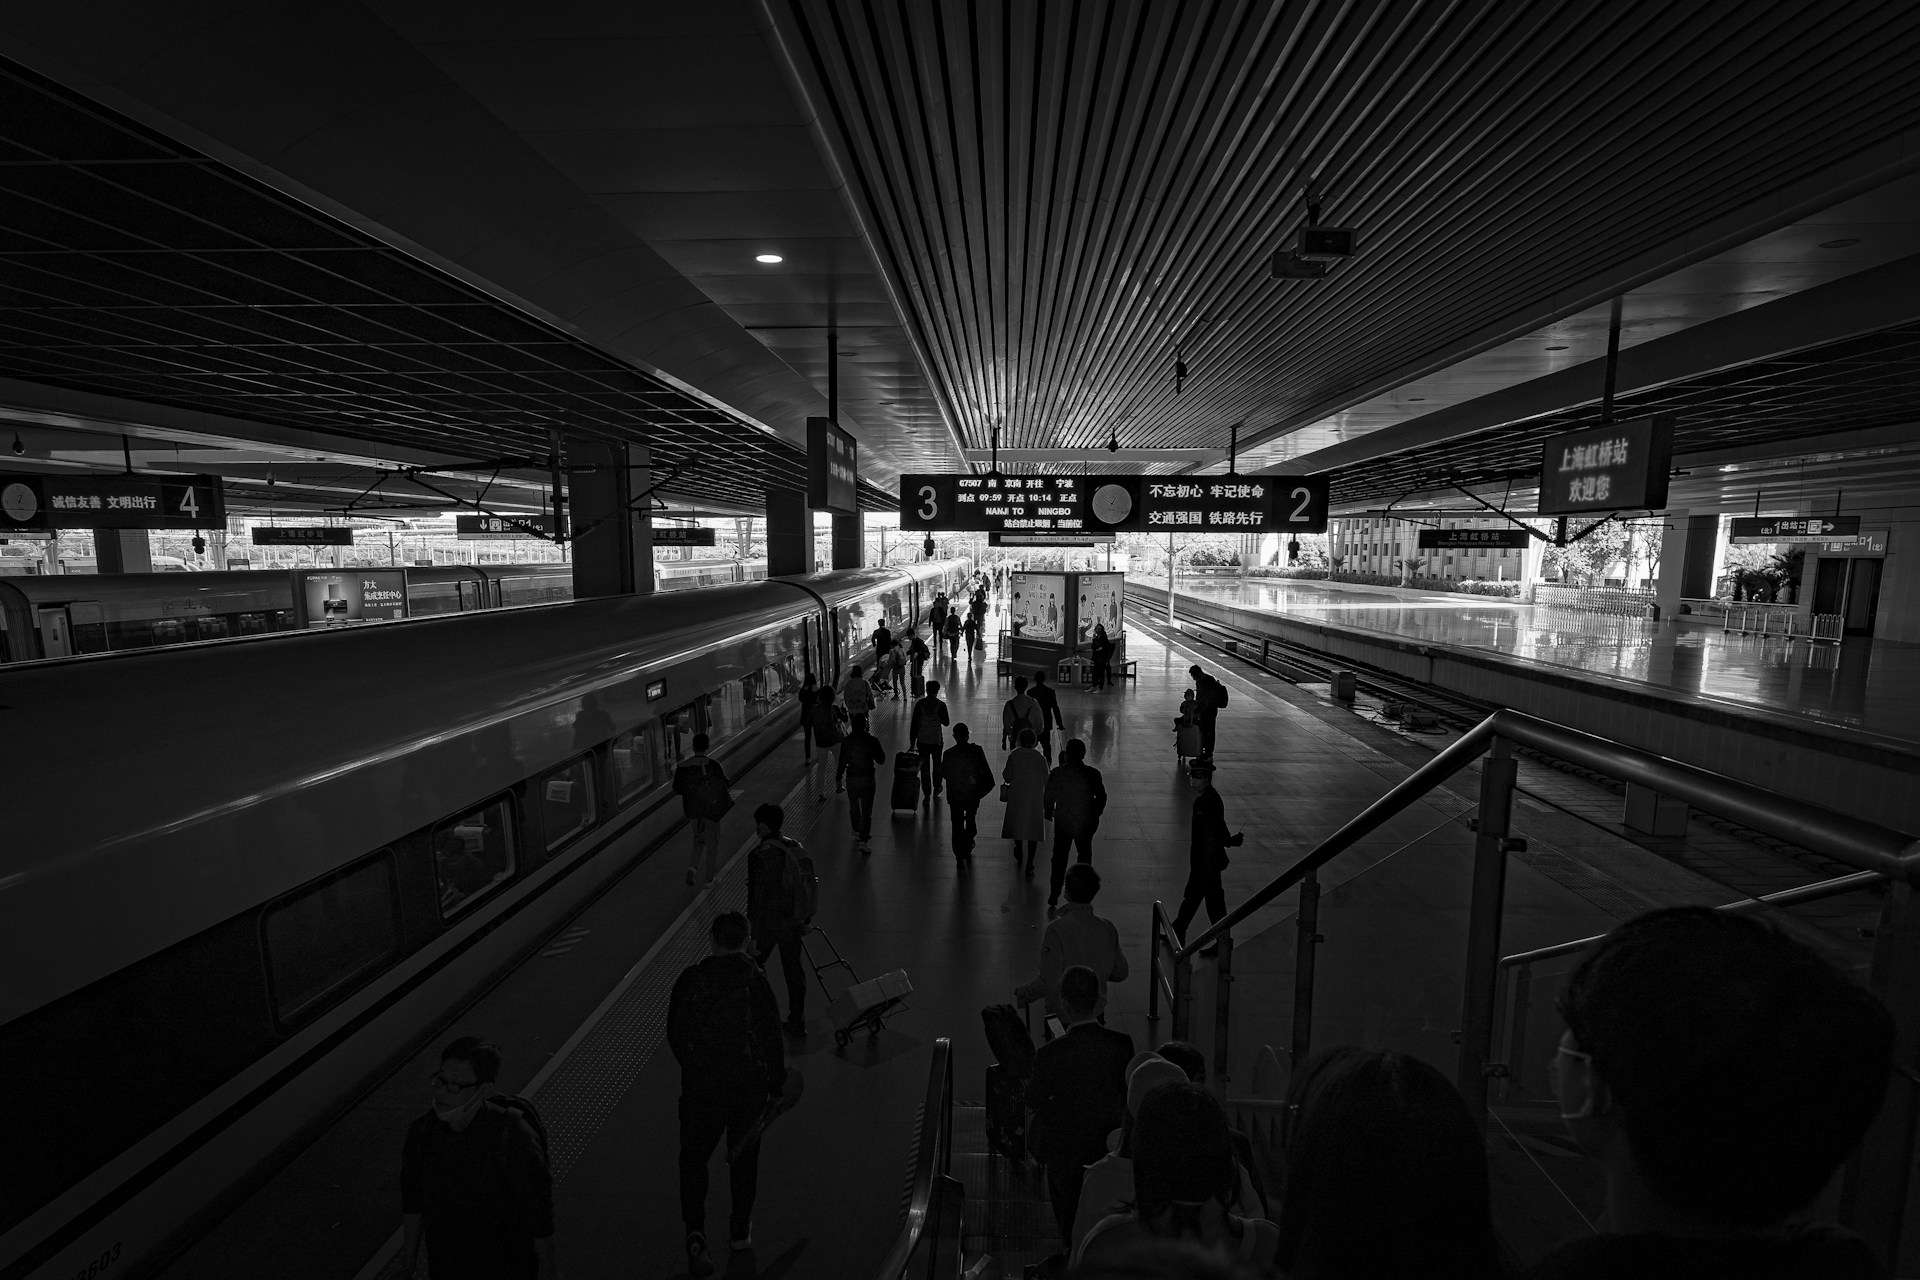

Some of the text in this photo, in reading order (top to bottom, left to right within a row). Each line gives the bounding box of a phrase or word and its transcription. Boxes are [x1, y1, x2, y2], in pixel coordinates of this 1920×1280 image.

[1559, 438, 1628, 472] 上海虹桥站
[1026, 479, 1043, 488] 开往
[1056, 479, 1073, 488] 宁波
[1569, 475, 1610, 502] 欢迎您
[958, 493, 975, 502] 到点
[1008, 494, 1024, 502] 开点
[1059, 494, 1077, 502] 正点
[1149, 484, 1264, 498] 不忘初心 牢记使命
[52, 496, 156, 508] 诚信友善 文明出行
[180, 486, 200, 518] 4
[918, 486, 937, 520] 3
[1289, 487, 1310, 521] 2
[1149, 511, 1263, 525] 交通强国 铁路先行
[1448, 532, 1500, 541] 上海虹桥站
